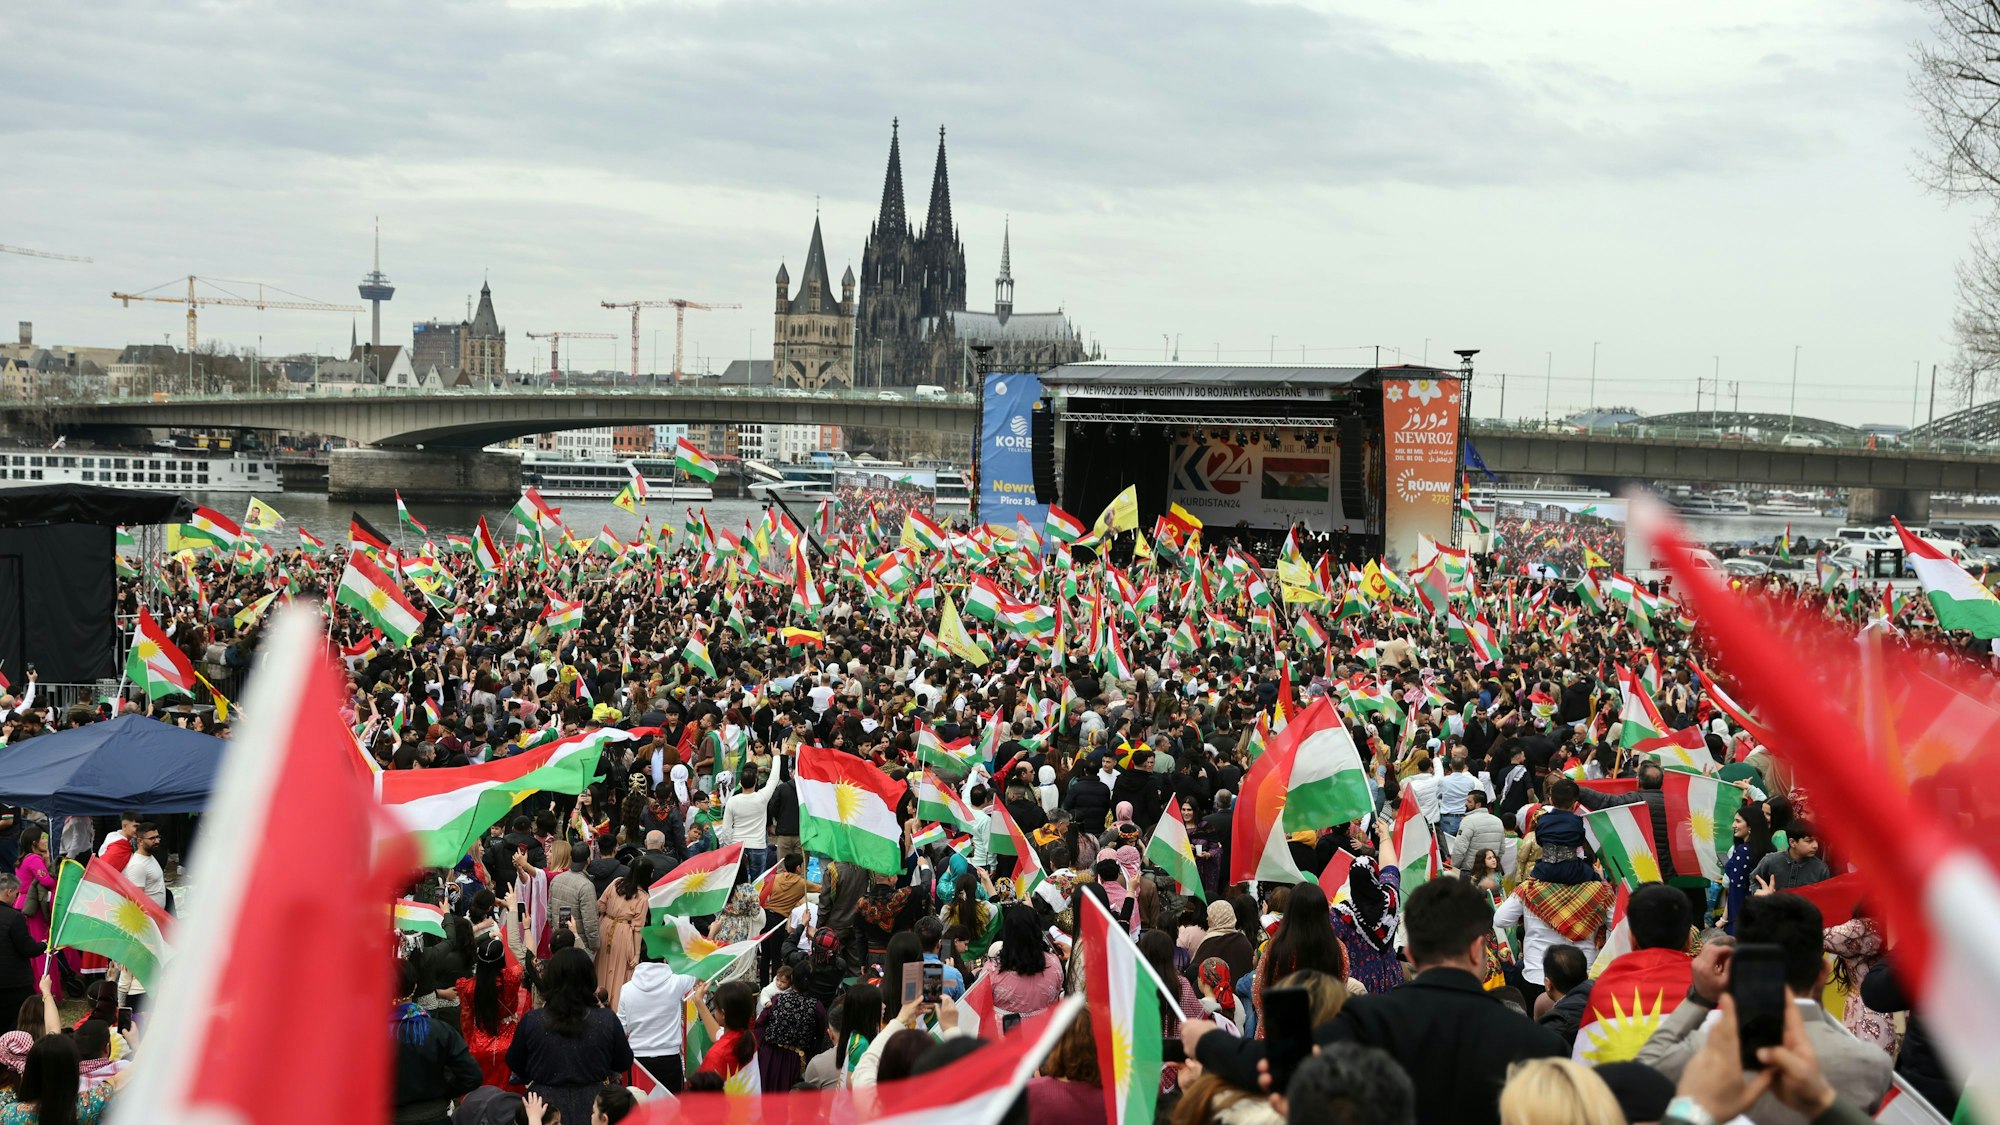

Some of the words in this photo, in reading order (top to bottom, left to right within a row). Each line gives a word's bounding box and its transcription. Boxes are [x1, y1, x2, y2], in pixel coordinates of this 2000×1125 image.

[1083, 385, 1116, 395] NEWROZ
[1118, 385, 1138, 396] 2025
[1194, 387, 1206, 397] BO
[1394, 431, 1454, 445] NEWROZ
[1285, 445, 1295, 453] MIL
[1180, 496, 1241, 509] KURDISTAN24
[1432, 494, 1450, 505] 2725
